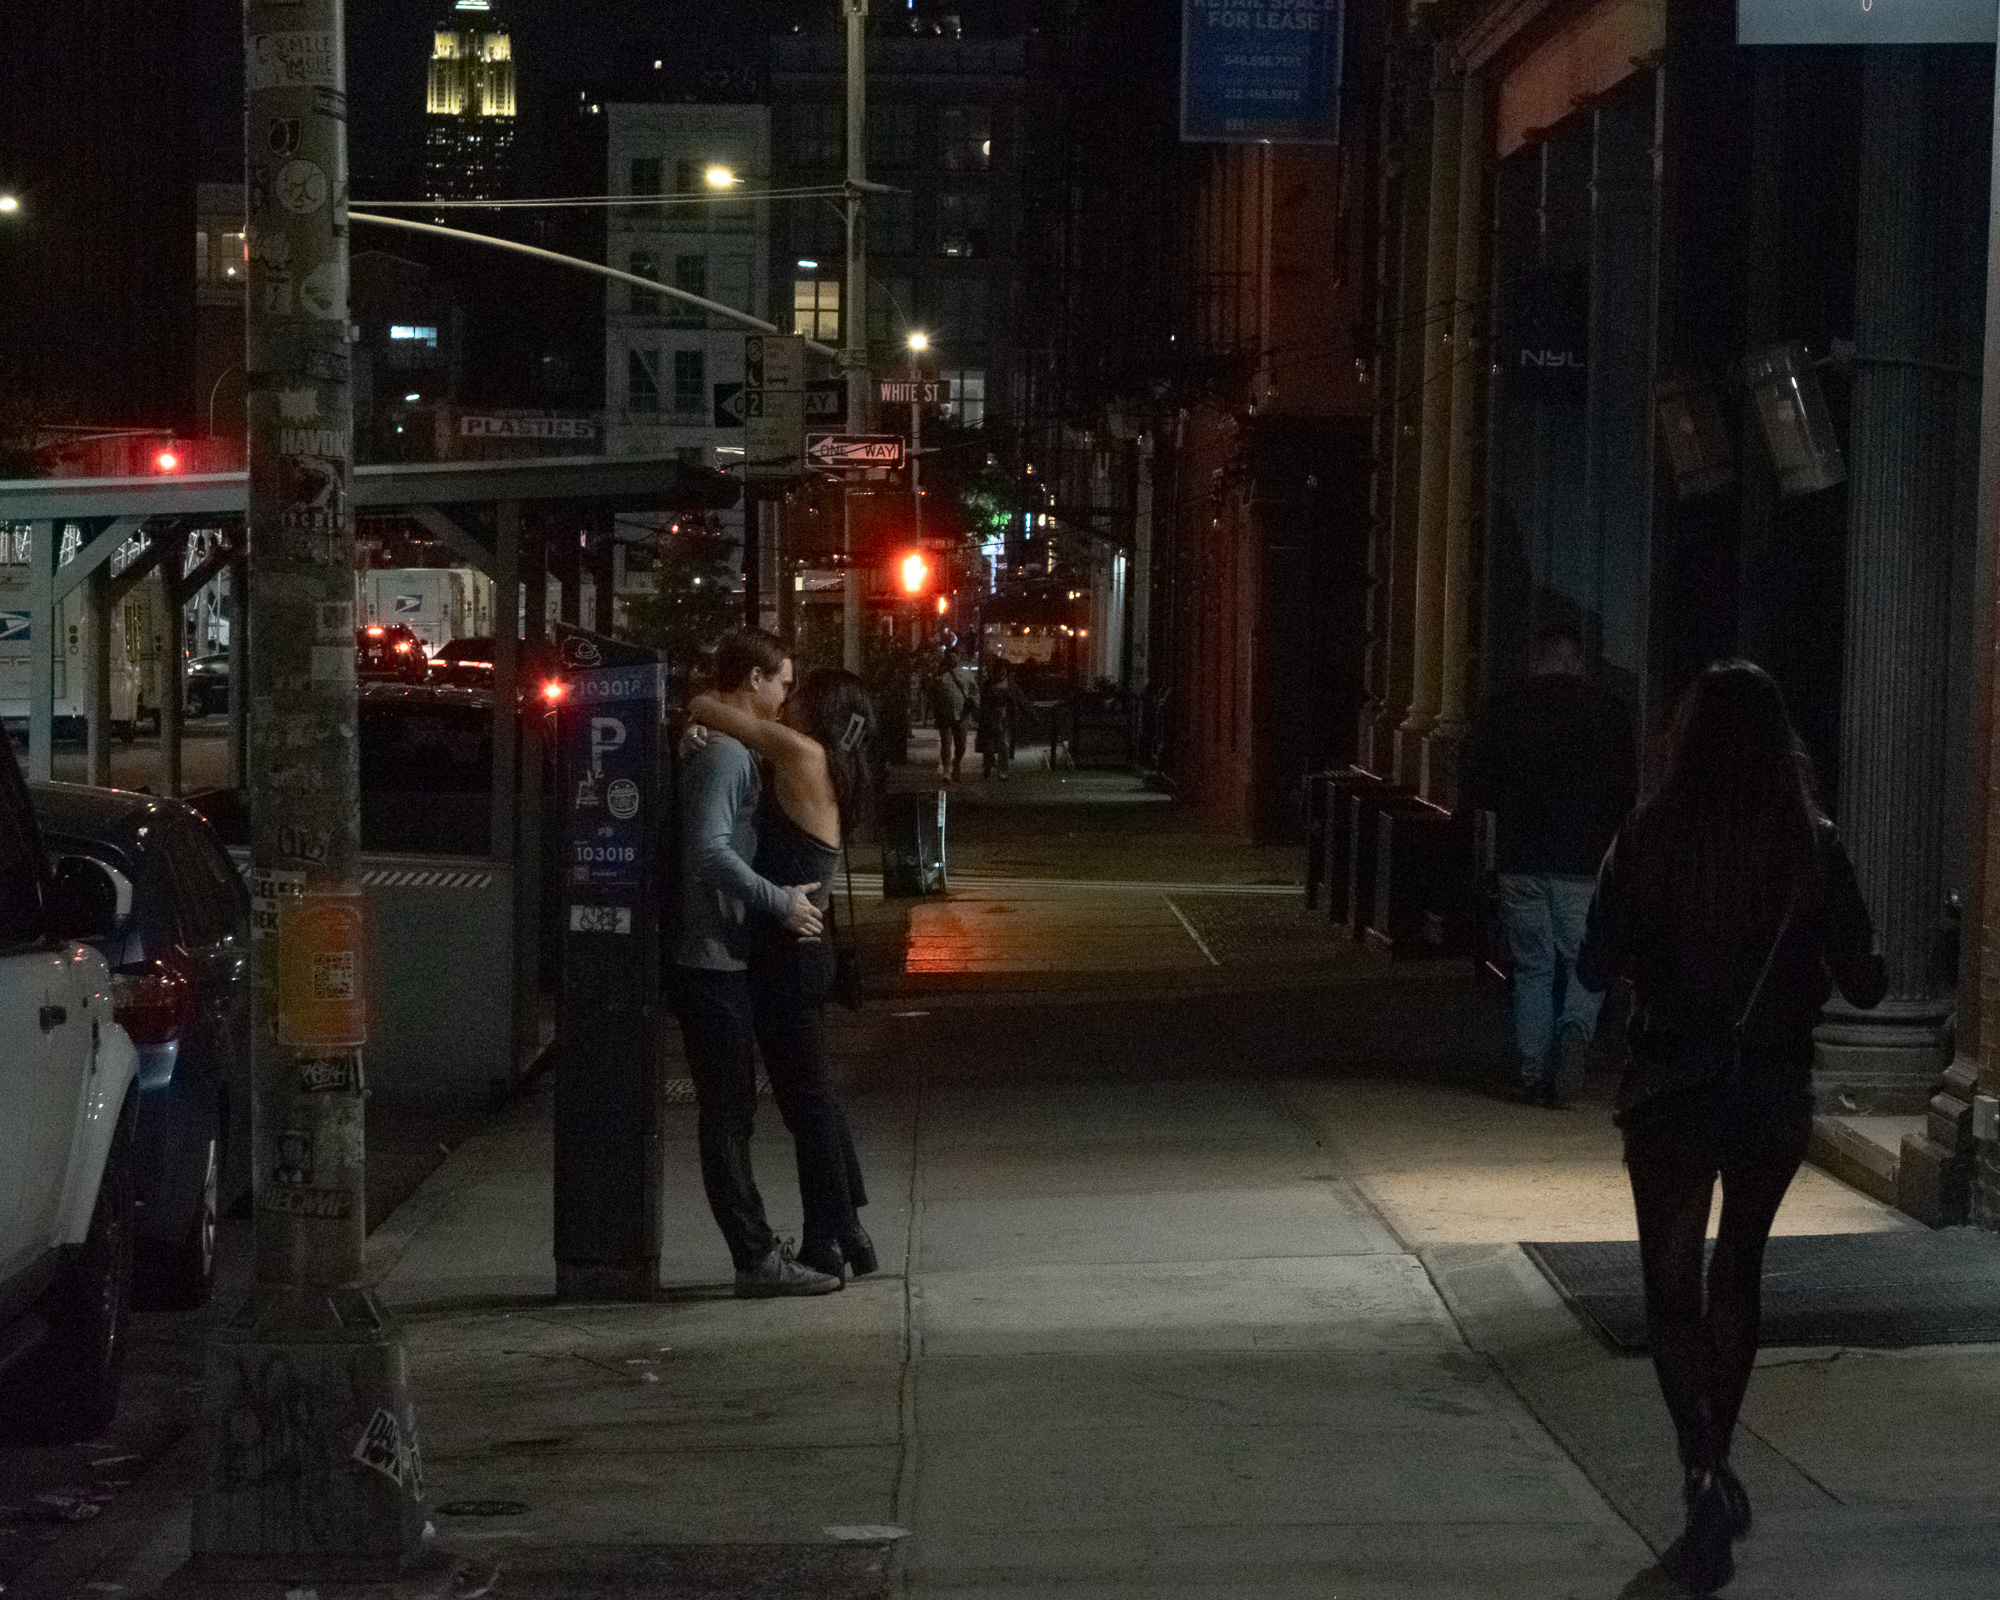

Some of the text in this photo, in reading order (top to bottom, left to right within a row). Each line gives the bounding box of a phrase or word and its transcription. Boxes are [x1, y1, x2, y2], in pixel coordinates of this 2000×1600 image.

[1208, 11, 1320, 30] FOR LEASE
[880, 383, 940, 402] WHITE ST
[467, 419, 590, 436] PLASTICS
[820, 445, 896, 457] ONE WAY
[577, 847, 635, 861] 103018
